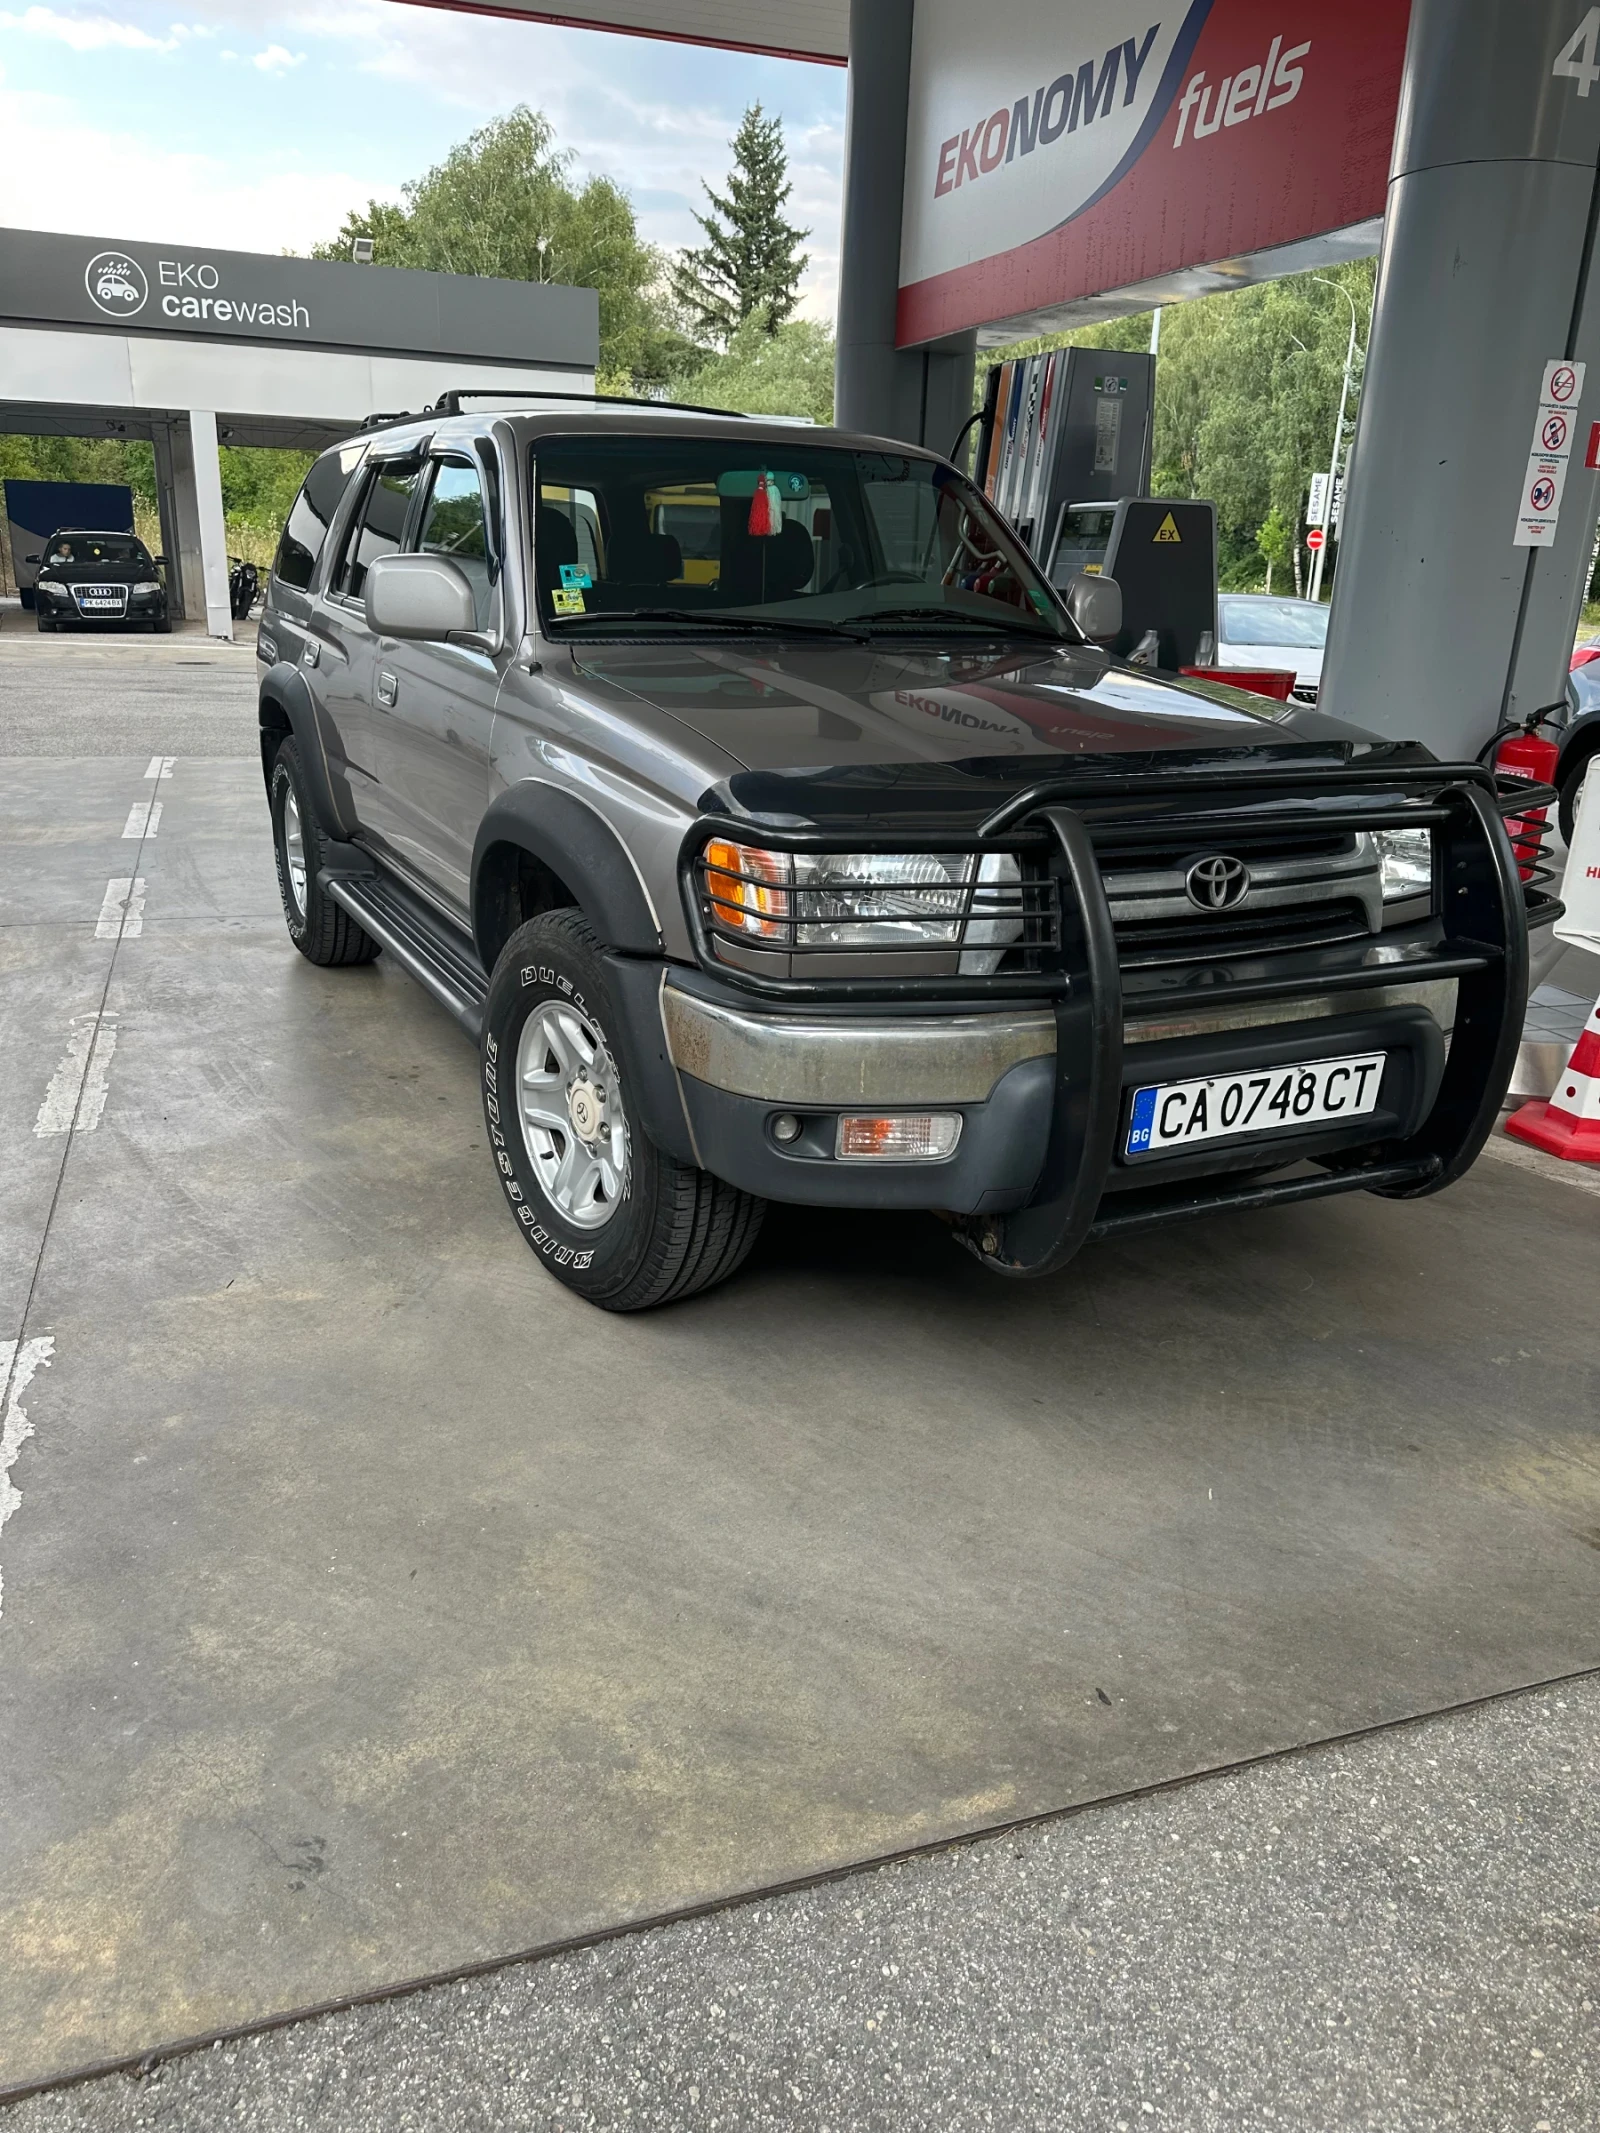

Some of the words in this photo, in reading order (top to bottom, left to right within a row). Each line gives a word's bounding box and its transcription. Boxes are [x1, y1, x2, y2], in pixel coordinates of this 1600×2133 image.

[1552, 5, 1600, 97] 4
[933, 22, 1162, 199] EKONOMY
[1172, 34, 1312, 149] fuels
[158, 261, 219, 289] EKO
[162, 295, 310, 328] carewash
[1311, 477, 1322, 521] SESAME
[1330, 478, 1343, 523] SESAME
[1159, 529, 1175, 541] EX
[1159, 1088, 1208, 1139] CA
[1220, 1072, 1316, 1127] 0748
[1323, 1063, 1377, 1110] CT
[486, 1032, 594, 1268] BRIDGESTONE
[1132, 1128, 1150, 1144] BG
